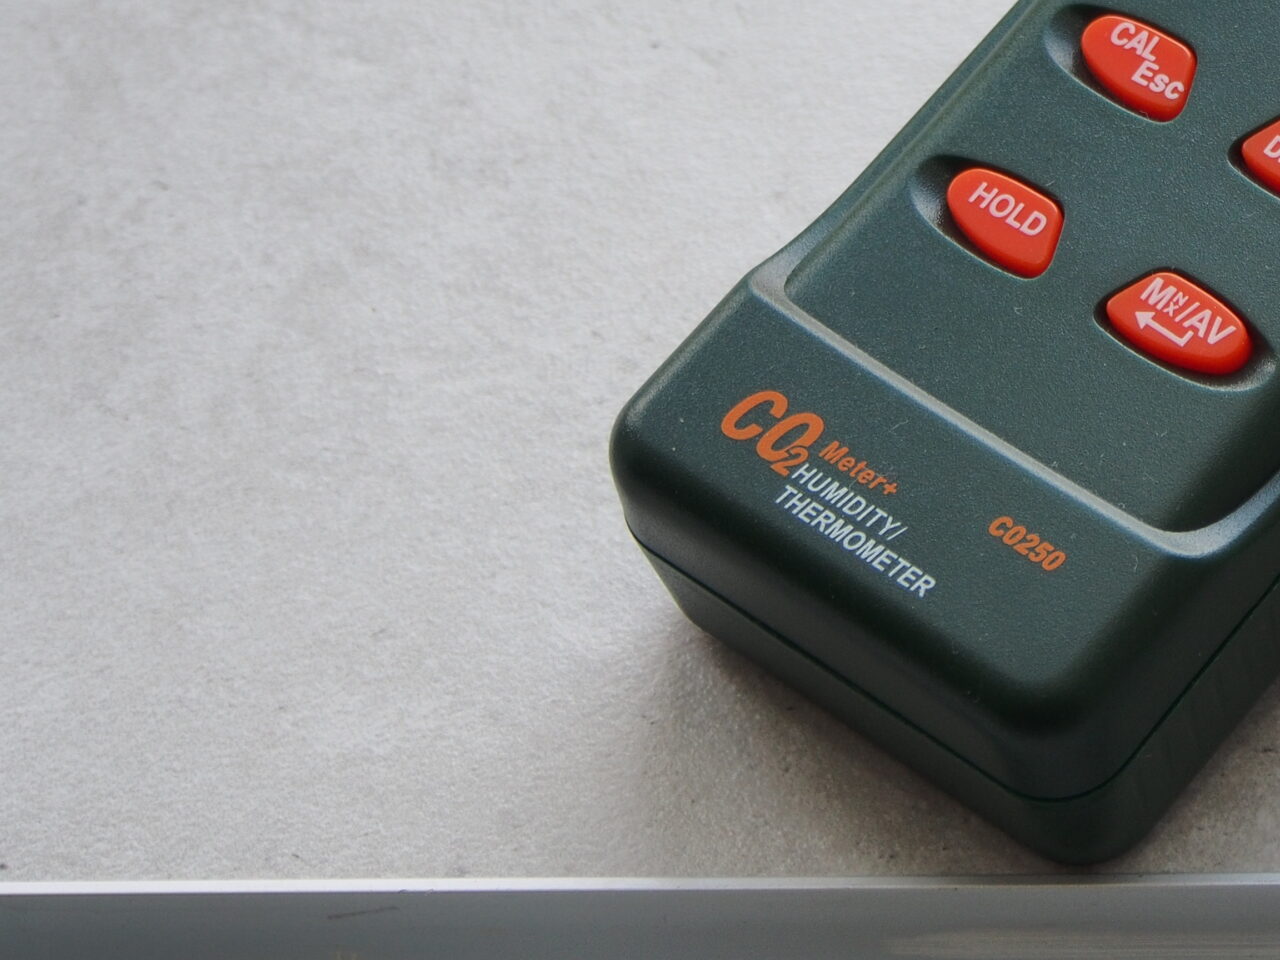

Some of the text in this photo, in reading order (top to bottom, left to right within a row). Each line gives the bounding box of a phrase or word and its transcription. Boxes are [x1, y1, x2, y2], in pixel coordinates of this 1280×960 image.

[1110, 22, 1158, 61] CAL
[1131, 60, 1185, 100] Esc
[968, 182, 1047, 237] HOLD
[819, 441, 898, 496] Meter+
[792, 463, 909, 540] HUMIDITY/
[774, 485, 937, 598] THERMOMETER
